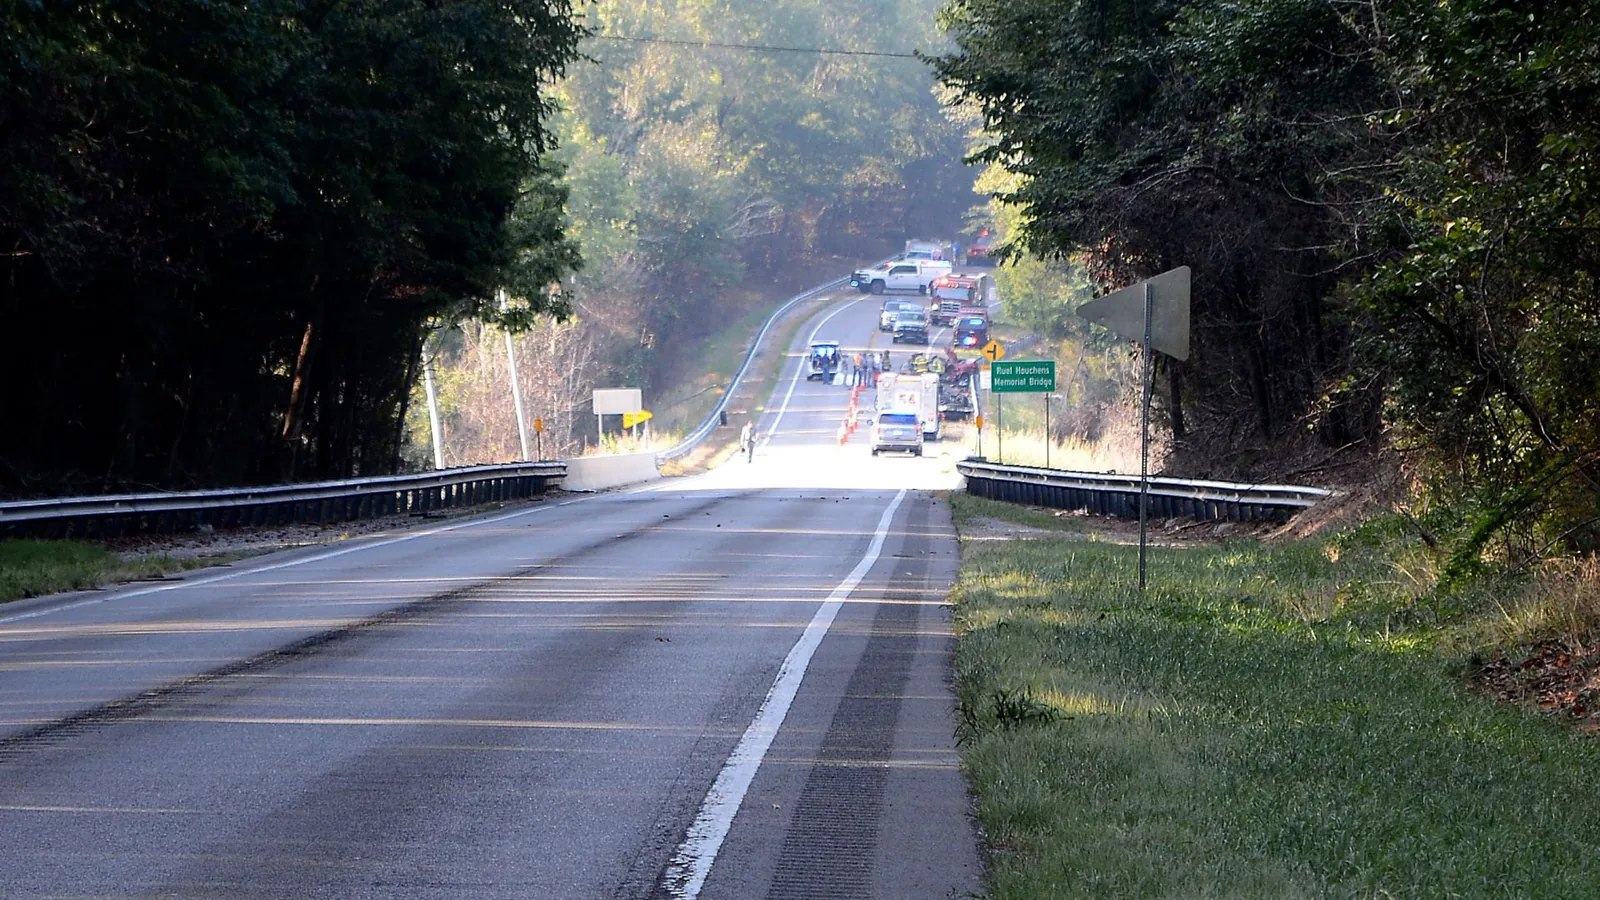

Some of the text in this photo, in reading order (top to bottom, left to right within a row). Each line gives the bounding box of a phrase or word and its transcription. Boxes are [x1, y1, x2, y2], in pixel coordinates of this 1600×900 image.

[1015, 366, 1050, 375] Houchens
[994, 377, 1026, 386] Memorial
[1029, 377, 1053, 388] Bridge
